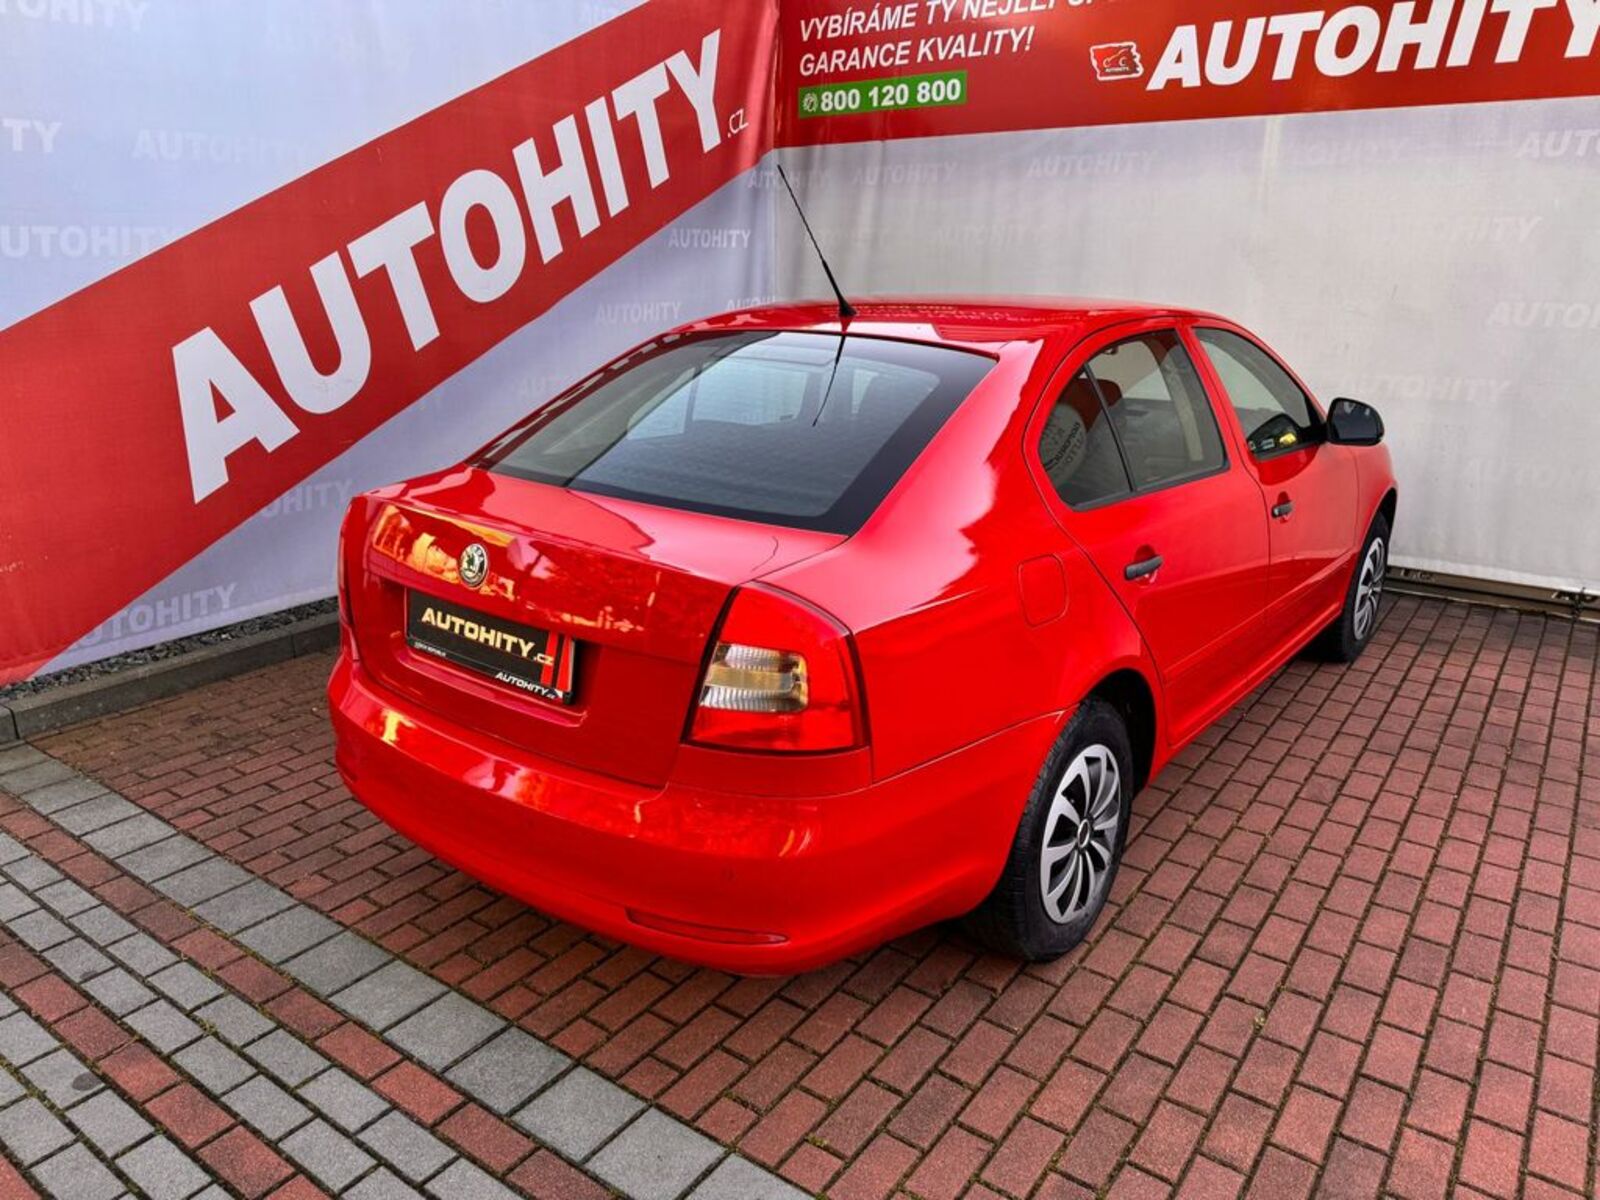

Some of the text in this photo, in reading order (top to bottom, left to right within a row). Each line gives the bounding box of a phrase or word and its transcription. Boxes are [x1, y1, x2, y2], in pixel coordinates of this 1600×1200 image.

[799, 5, 916, 42] VYBÍRÁME
[926, 0, 957, 25] TY
[799, 26, 1036, 77] GARANCE KVALITY!
[1144, 0, 1600, 91] AUTOHITY
[820, 78, 962, 113] 800 120 800
[668, 228, 751, 249] AUTOHITY
[596, 299, 683, 327] AUTOHITY
